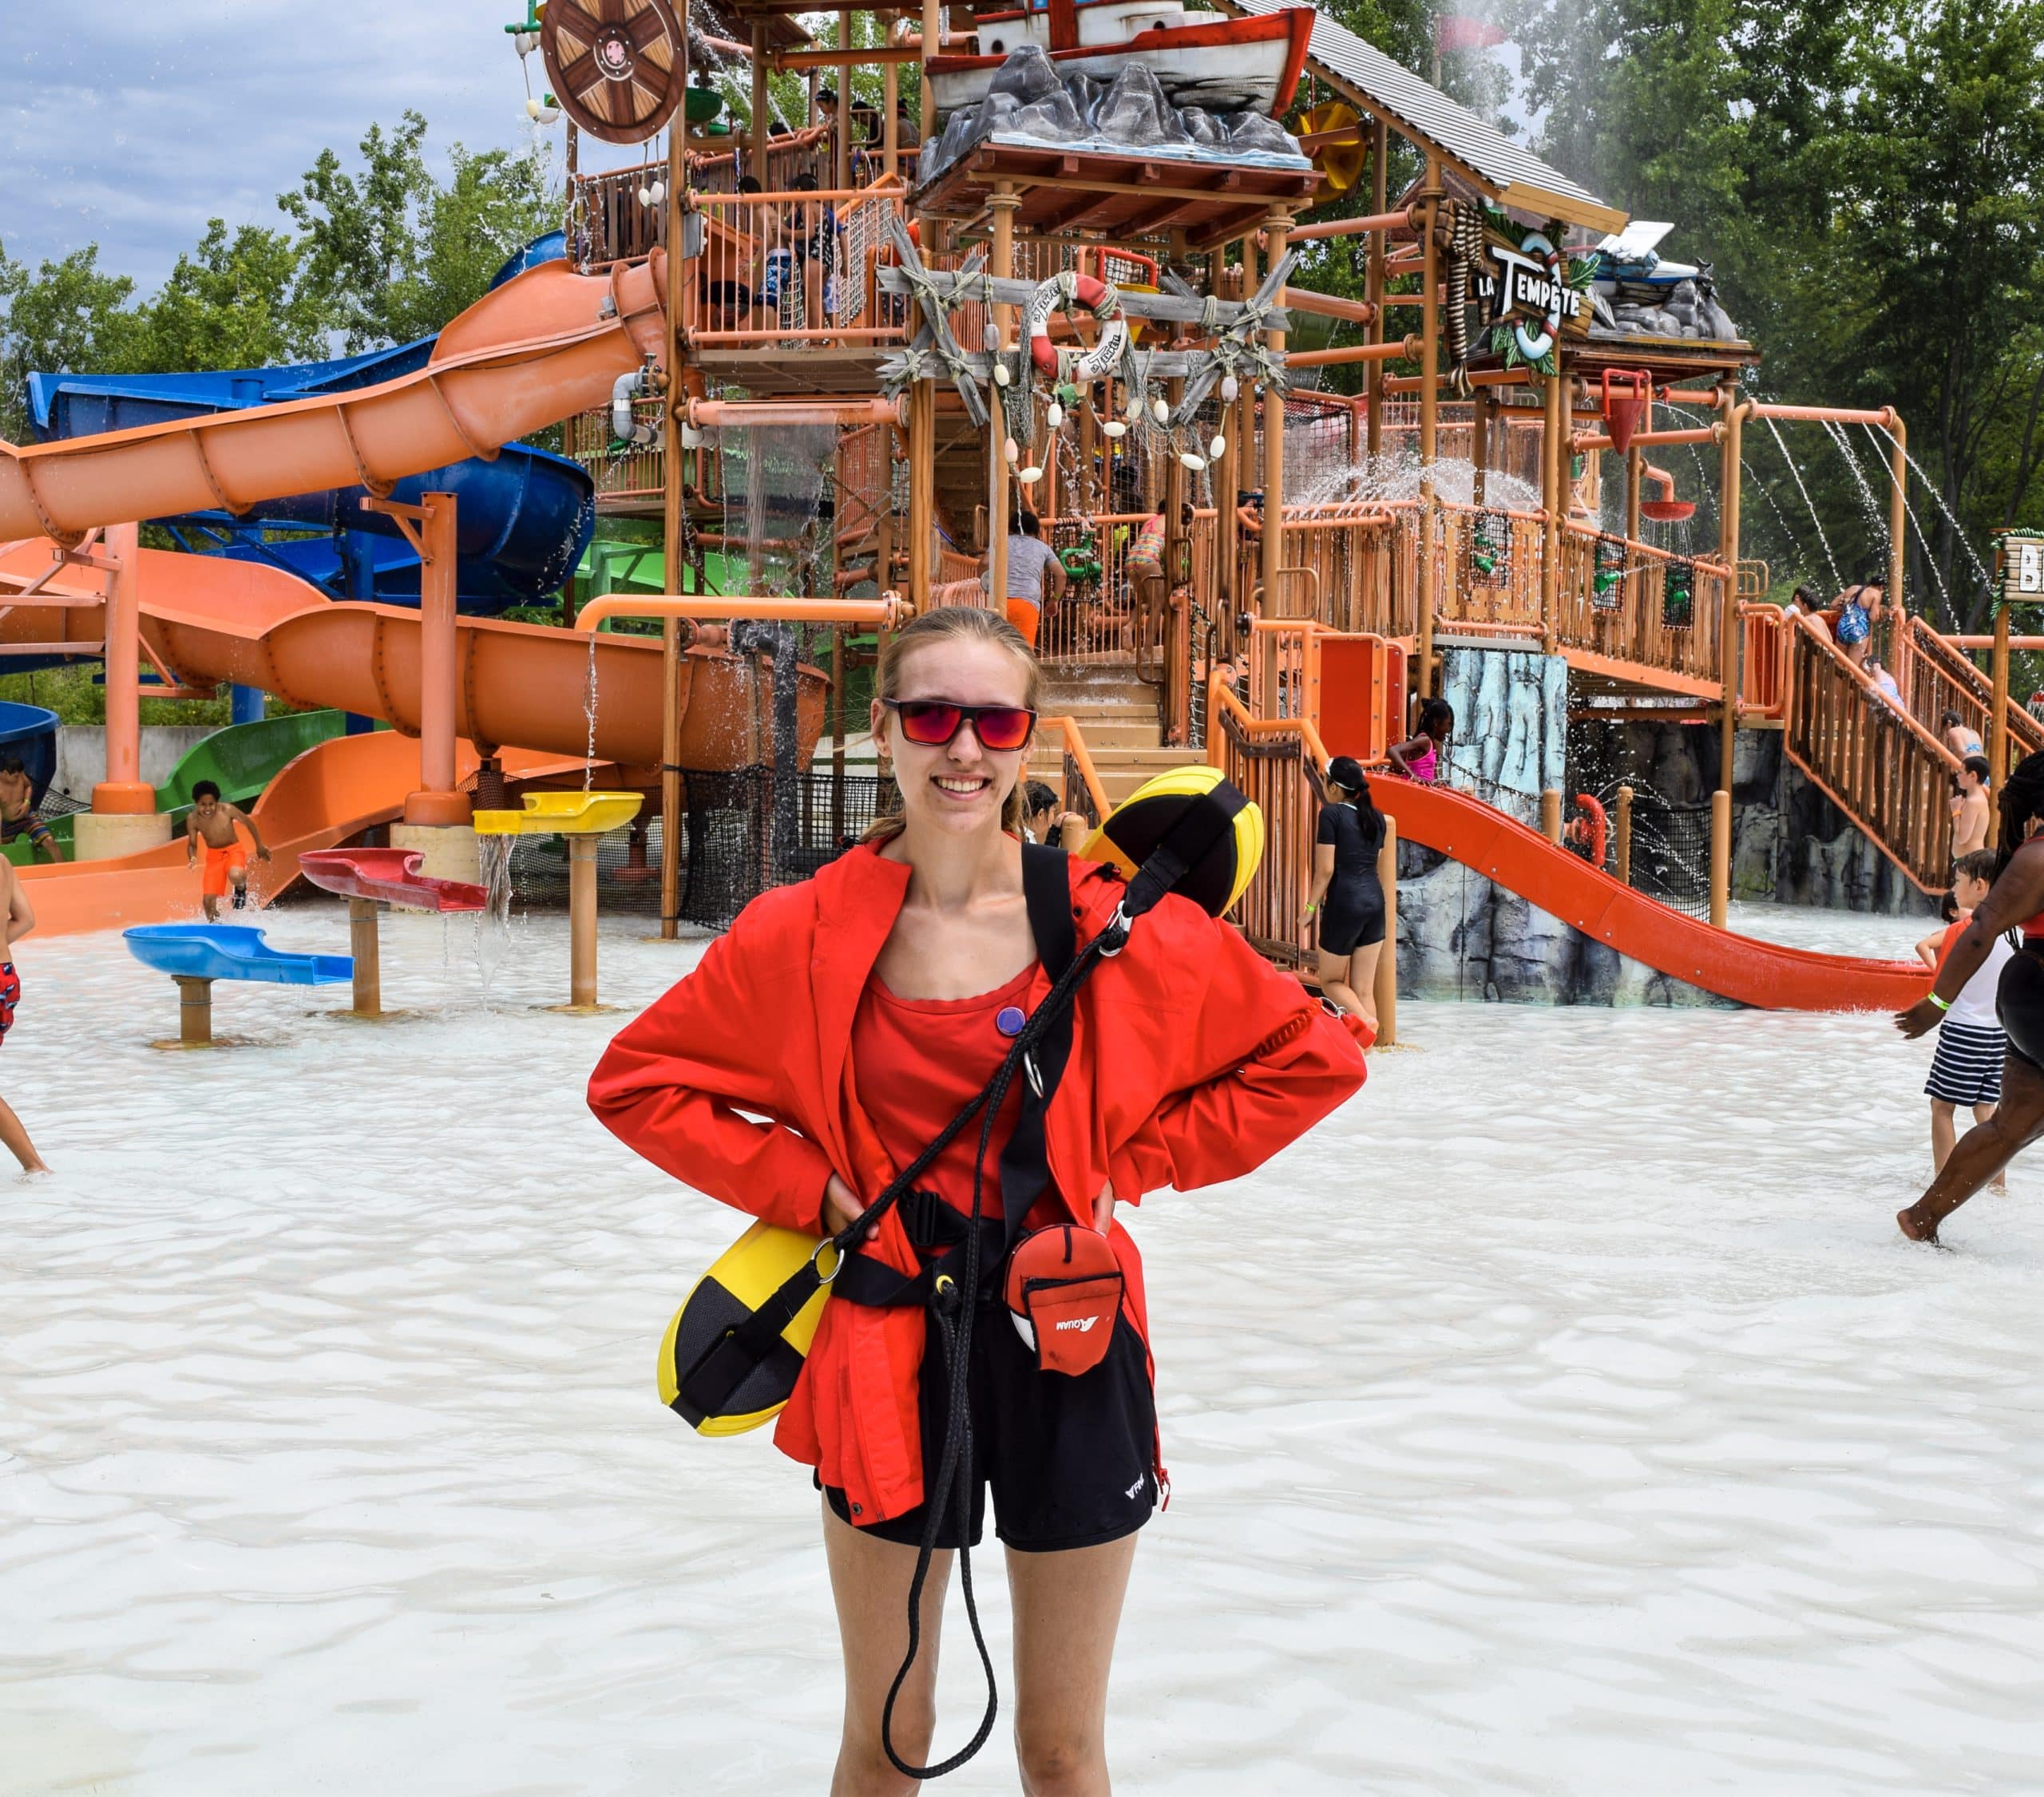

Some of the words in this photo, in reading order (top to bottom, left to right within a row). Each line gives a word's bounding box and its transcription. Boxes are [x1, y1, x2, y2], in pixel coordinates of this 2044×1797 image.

[1479, 276, 1495, 296] LA
[1491, 246, 1581, 317] TEMPÊTE
[2019, 544, 2044, 592] B
[1056, 1315, 1099, 1332] AQUAM
